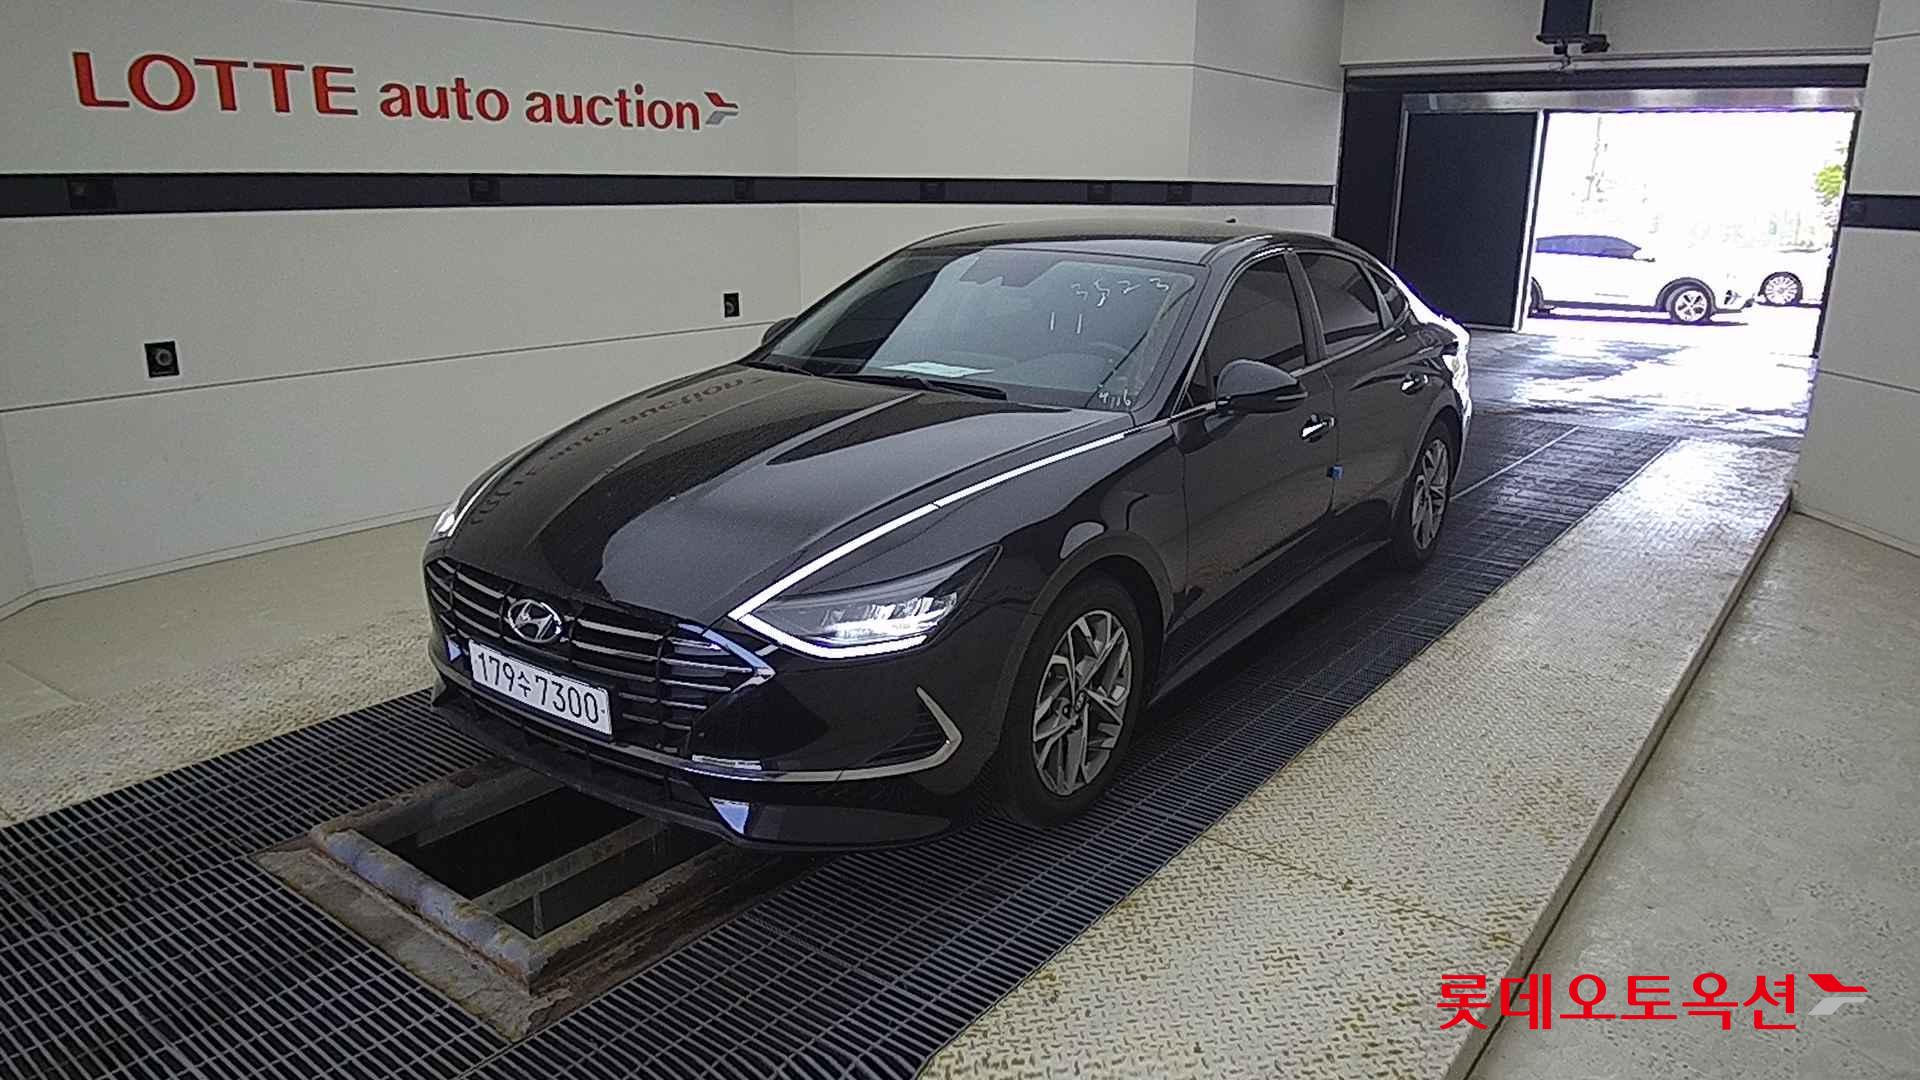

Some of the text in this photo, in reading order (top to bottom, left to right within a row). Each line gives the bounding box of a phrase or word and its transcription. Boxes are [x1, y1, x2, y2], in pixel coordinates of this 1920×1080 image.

[73, 51, 702, 130] LOTTE auto auction
